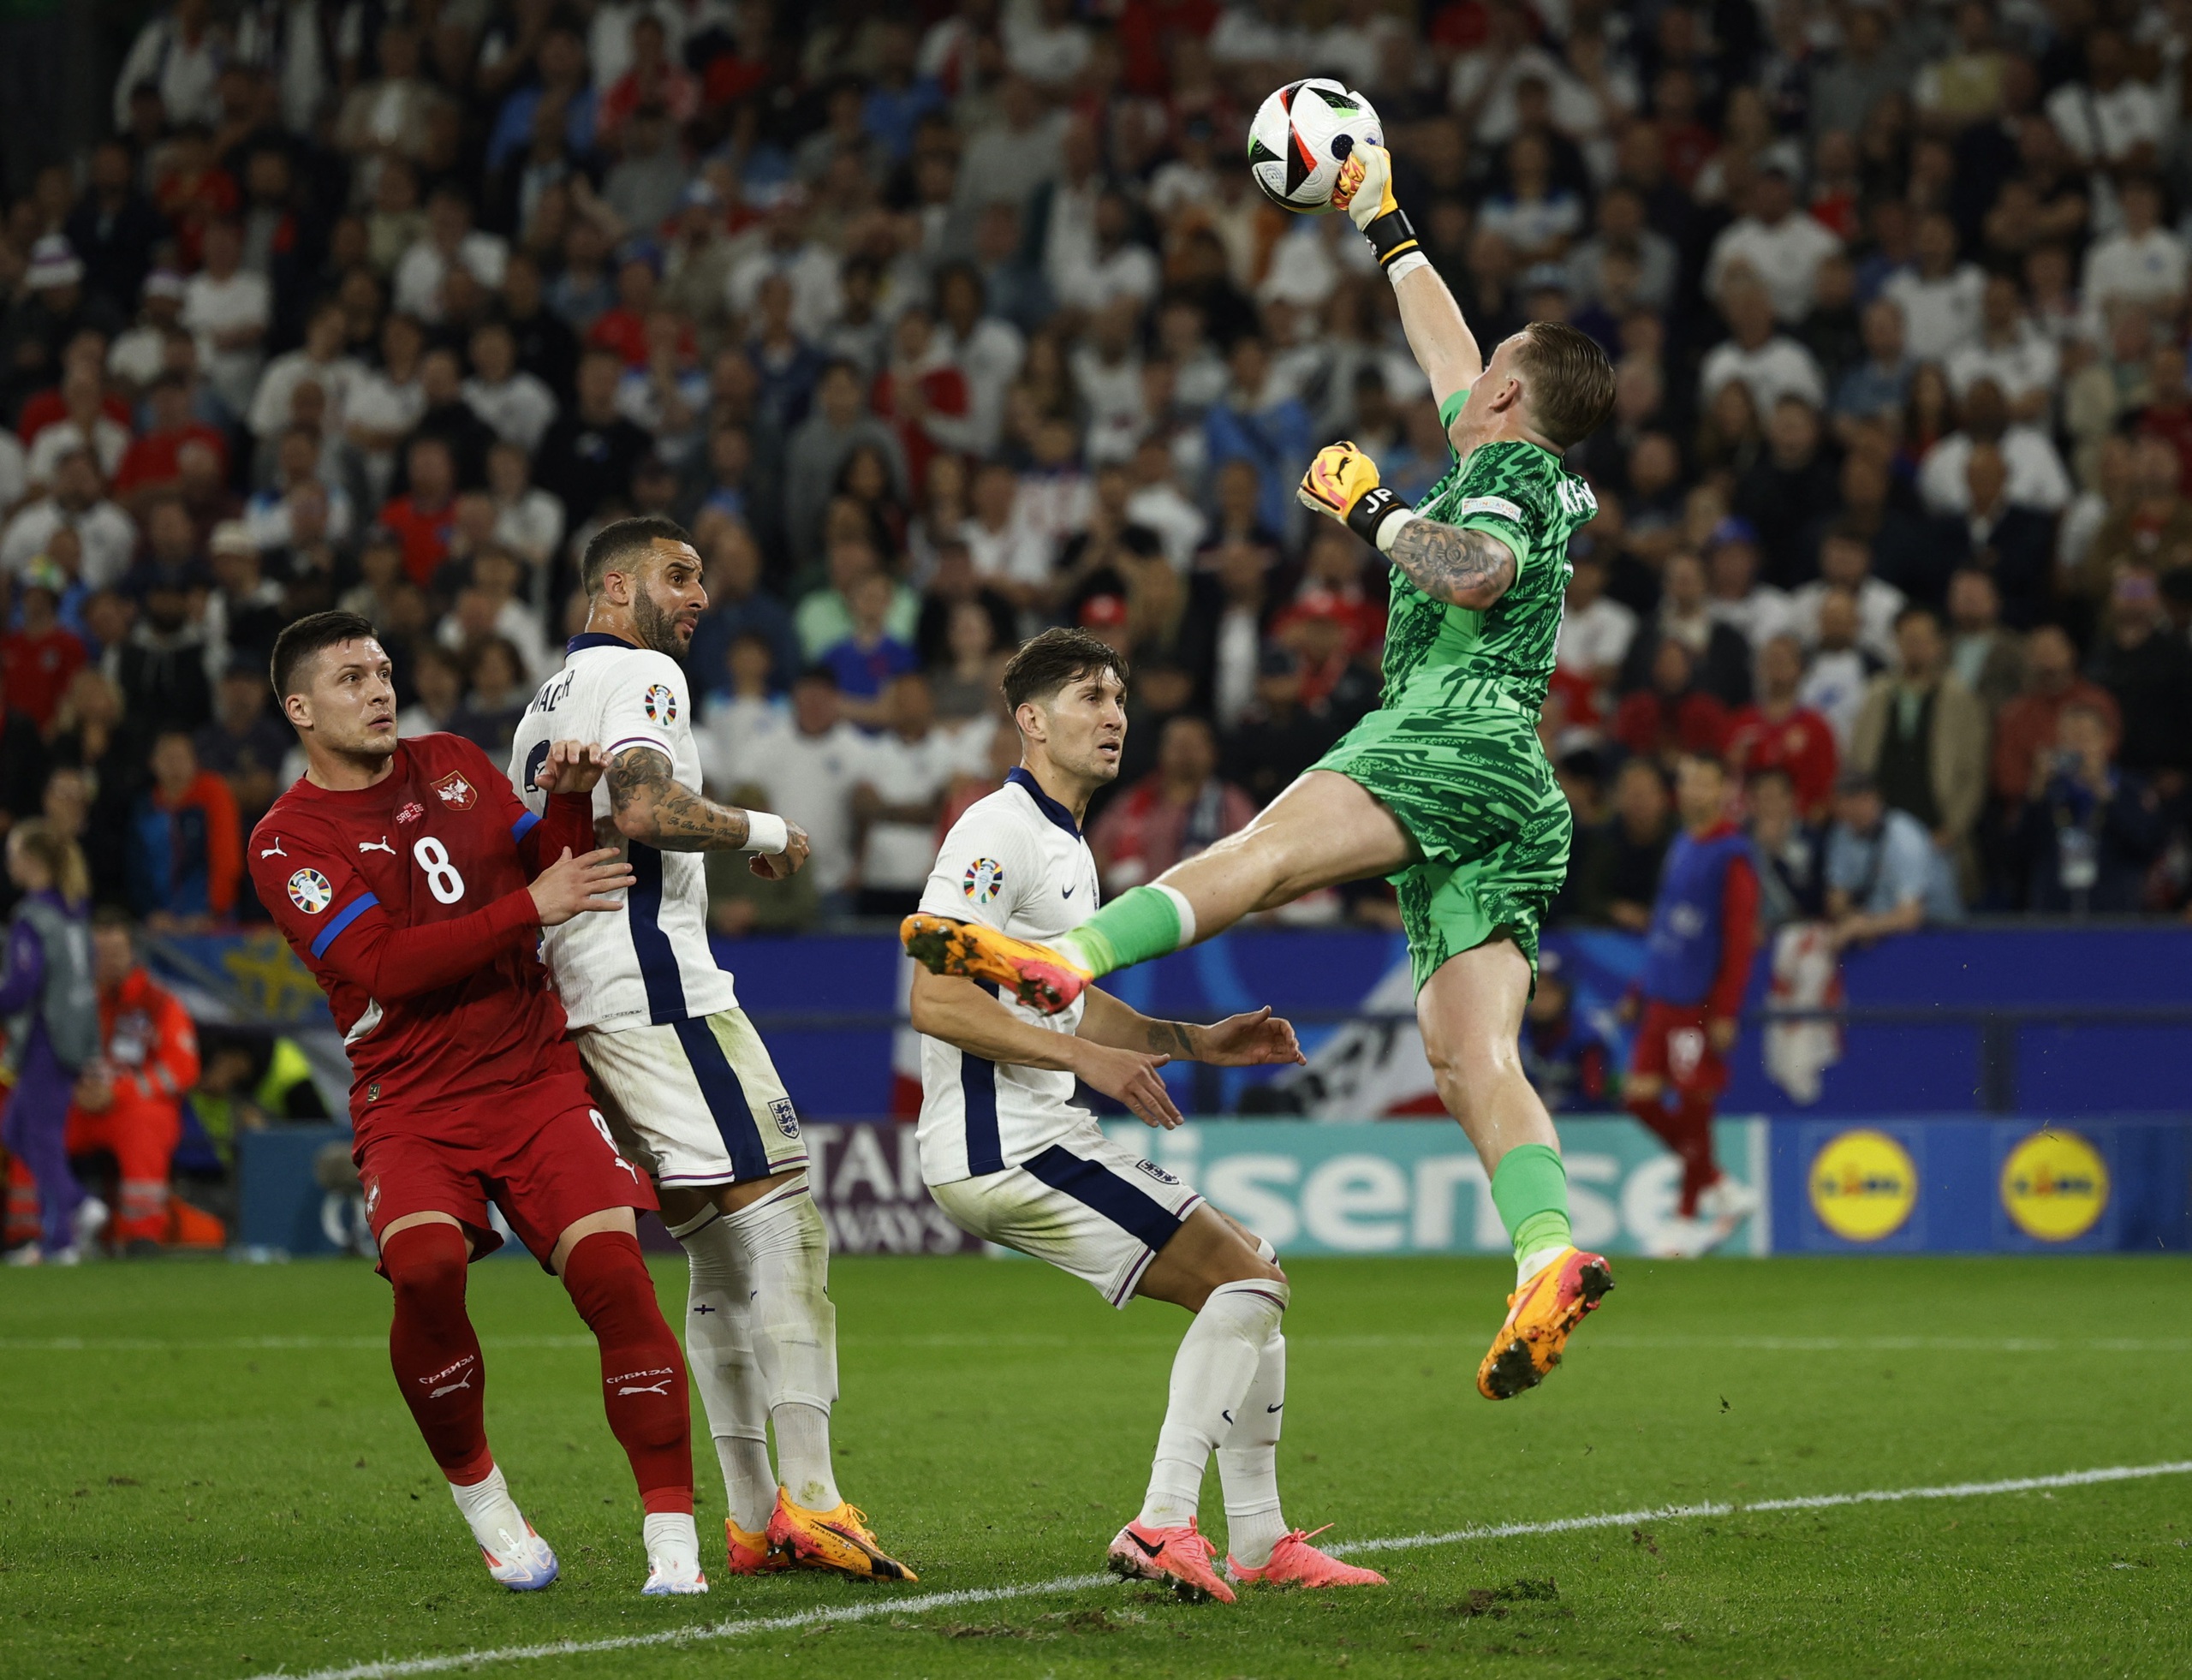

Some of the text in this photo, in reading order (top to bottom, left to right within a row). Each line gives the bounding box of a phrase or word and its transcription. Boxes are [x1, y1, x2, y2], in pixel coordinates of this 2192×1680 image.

[1365, 488, 1393, 514] JP
[1463, 501, 1520, 518] FOUNDATION
[414, 837, 465, 904] 8
[589, 1109, 620, 1157] 8
